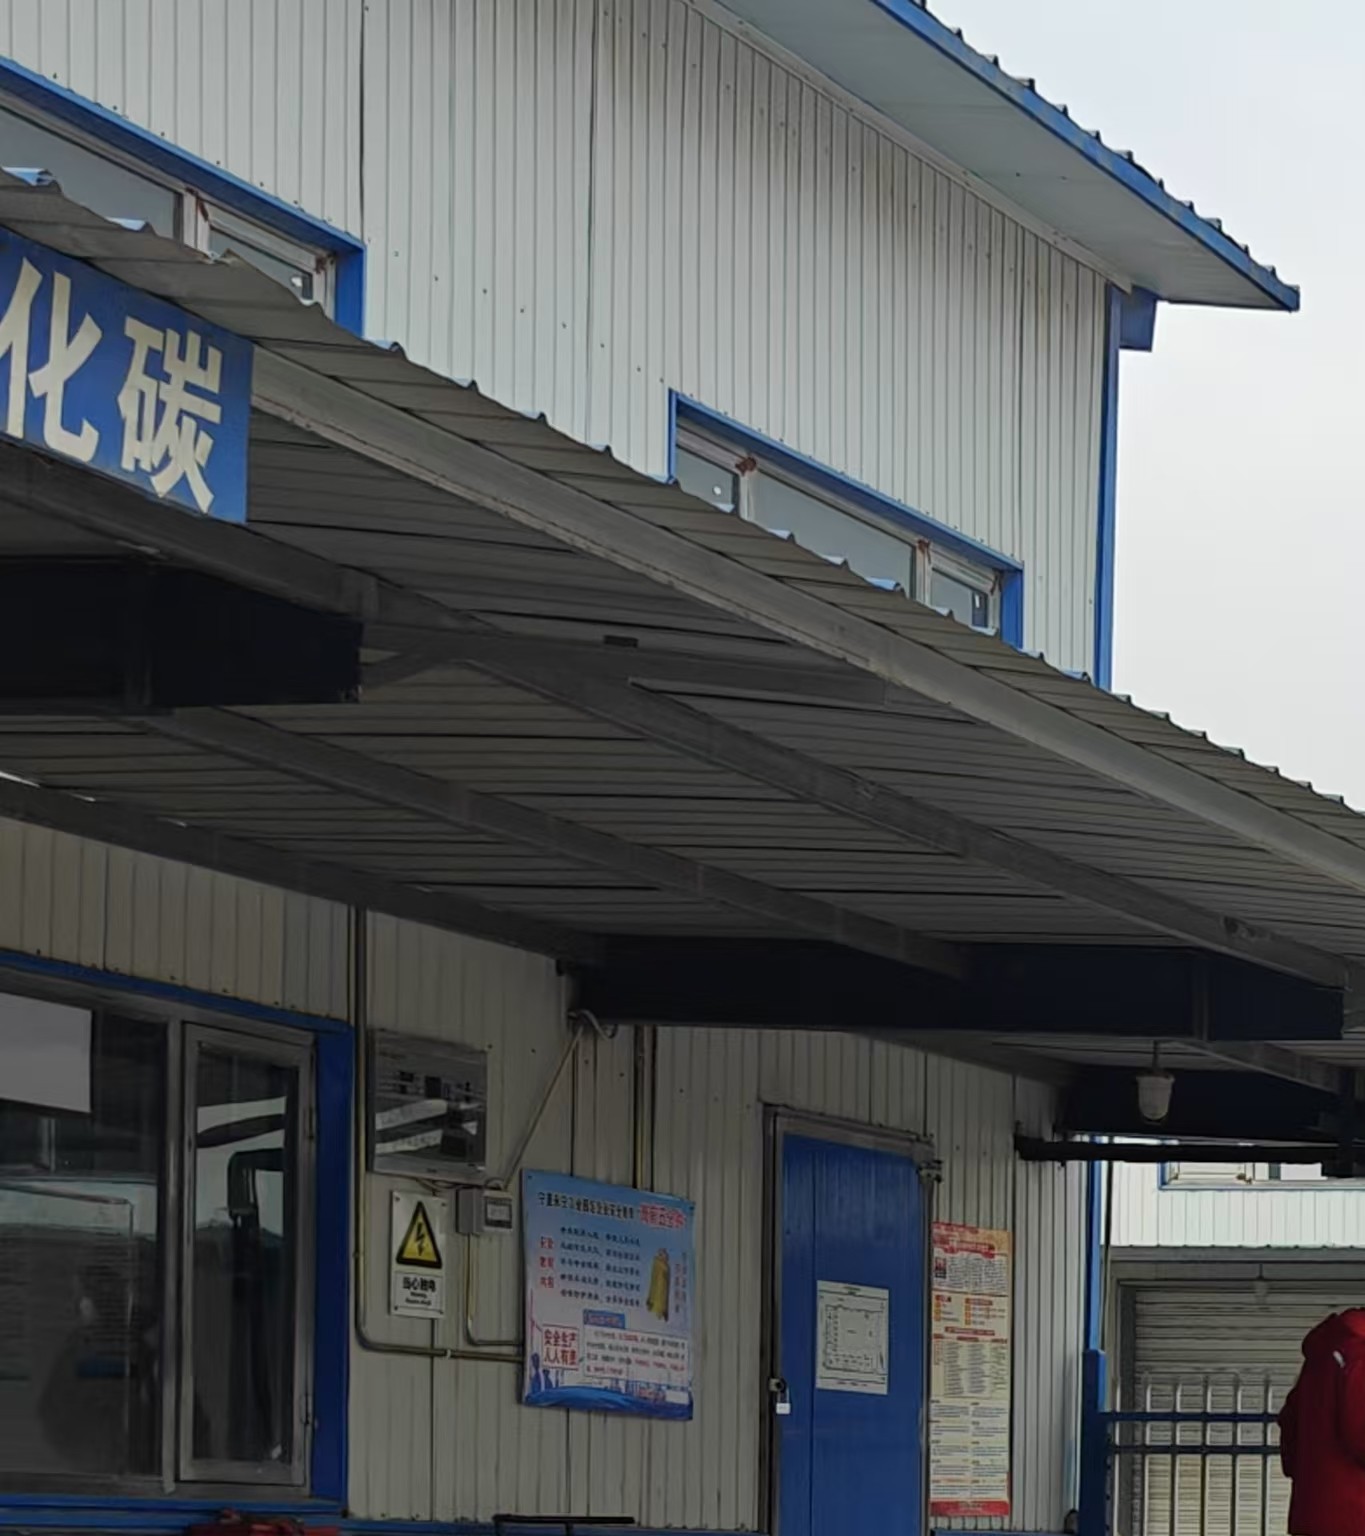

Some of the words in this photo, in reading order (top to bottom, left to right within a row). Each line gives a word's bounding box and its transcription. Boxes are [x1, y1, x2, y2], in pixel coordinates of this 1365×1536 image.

[0, 257, 223, 514] 化碳
[544, 1329, 576, 1348] 安全生产
[544, 1347, 576, 1366] 人人有责
